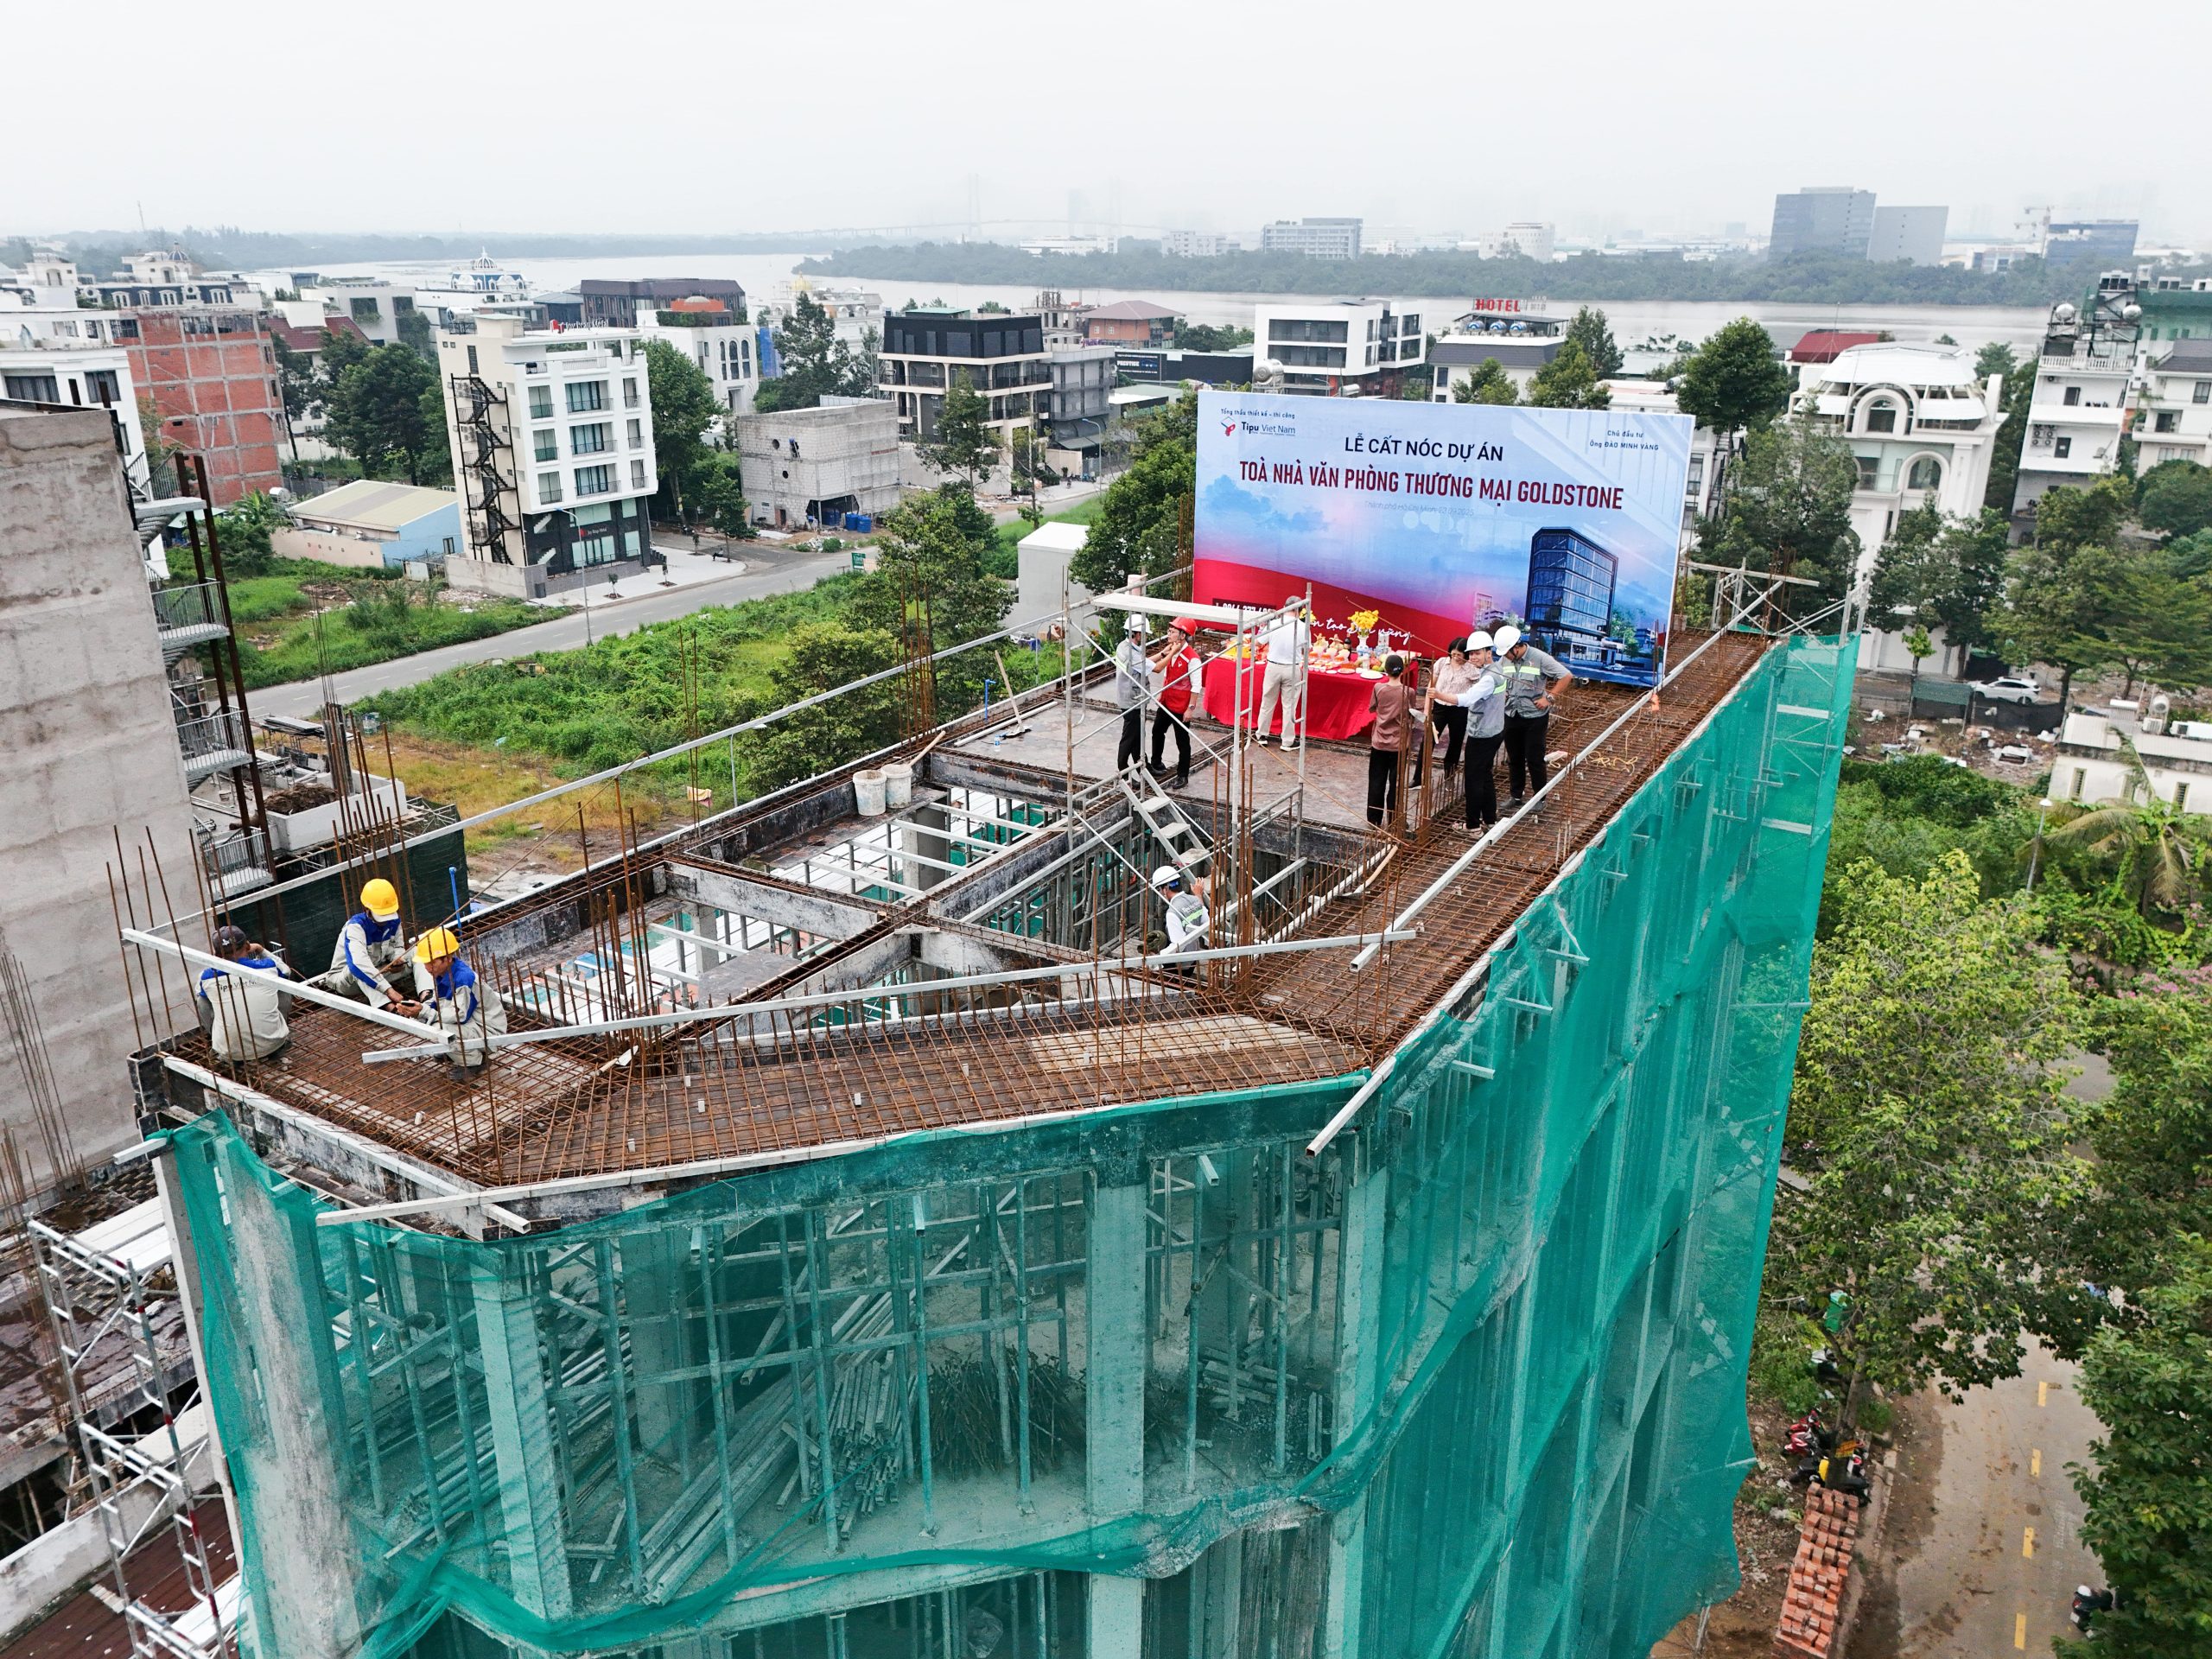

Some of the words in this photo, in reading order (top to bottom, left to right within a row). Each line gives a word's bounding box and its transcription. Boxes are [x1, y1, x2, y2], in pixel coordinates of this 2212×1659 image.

[1475, 298, 1521, 312] HOTEL
[1241, 422, 1259, 434] Tipu
[1262, 423, 1276, 432] Viet
[1278, 425, 1296, 434] Nam
[1344, 433, 1363, 452] LỄ
[1369, 435, 1402, 454] CẤT
[1406, 438, 1443, 457] NÓC
[1447, 443, 1475, 463] DỰ
[1477, 442, 1503, 461] ÁN
[1589, 439, 1602, 448] Ông
[1604, 440, 1618, 448] ĐÀO
[1640, 442, 1659, 450] VÀNG
[1240, 456, 1268, 482] TOÀ
[1273, 459, 1303, 485] NHÀ
[1309, 461, 1339, 488] VĂN
[1344, 464, 1399, 492] PHÒNG
[1405, 472, 1473, 499] THƯƠNG
[1479, 478, 1512, 506] MẠI
[1517, 480, 1624, 510] GOLDSTONE
[1326, 618, 1346, 631] tạo
